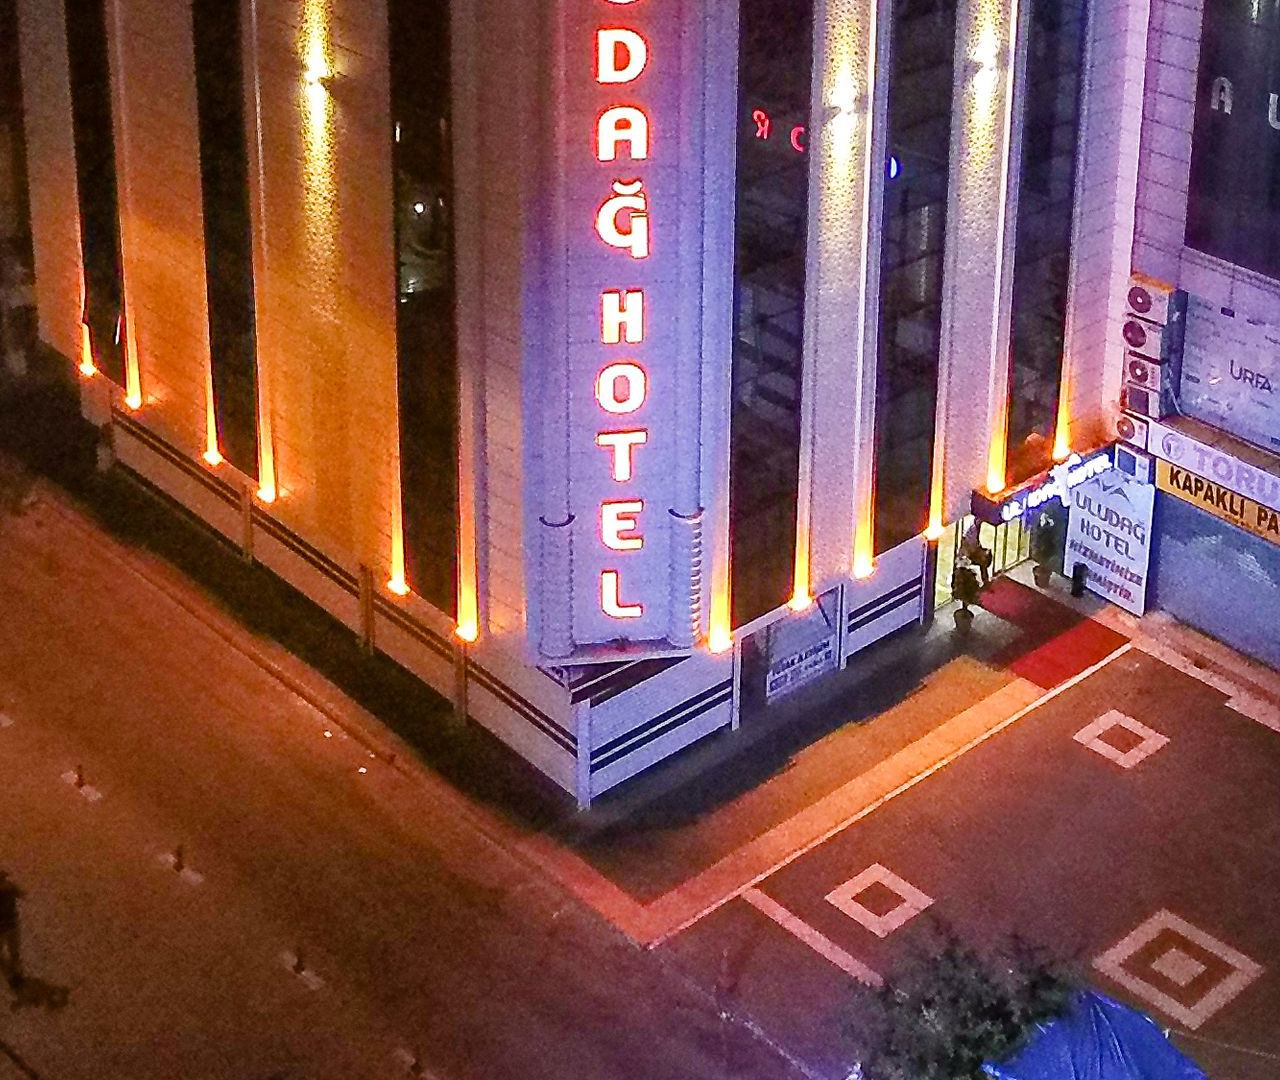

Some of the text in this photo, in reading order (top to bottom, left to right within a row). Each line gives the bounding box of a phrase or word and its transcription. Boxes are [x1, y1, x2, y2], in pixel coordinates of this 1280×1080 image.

[1229, 360, 1273, 394] URFA
[594, 289, 648, 619] HOTEL
[1193, 445, 1280, 504] TORU
[1169, 465, 1245, 519] KAPAKLI
[1080, 517, 1136, 562] HOTEL
